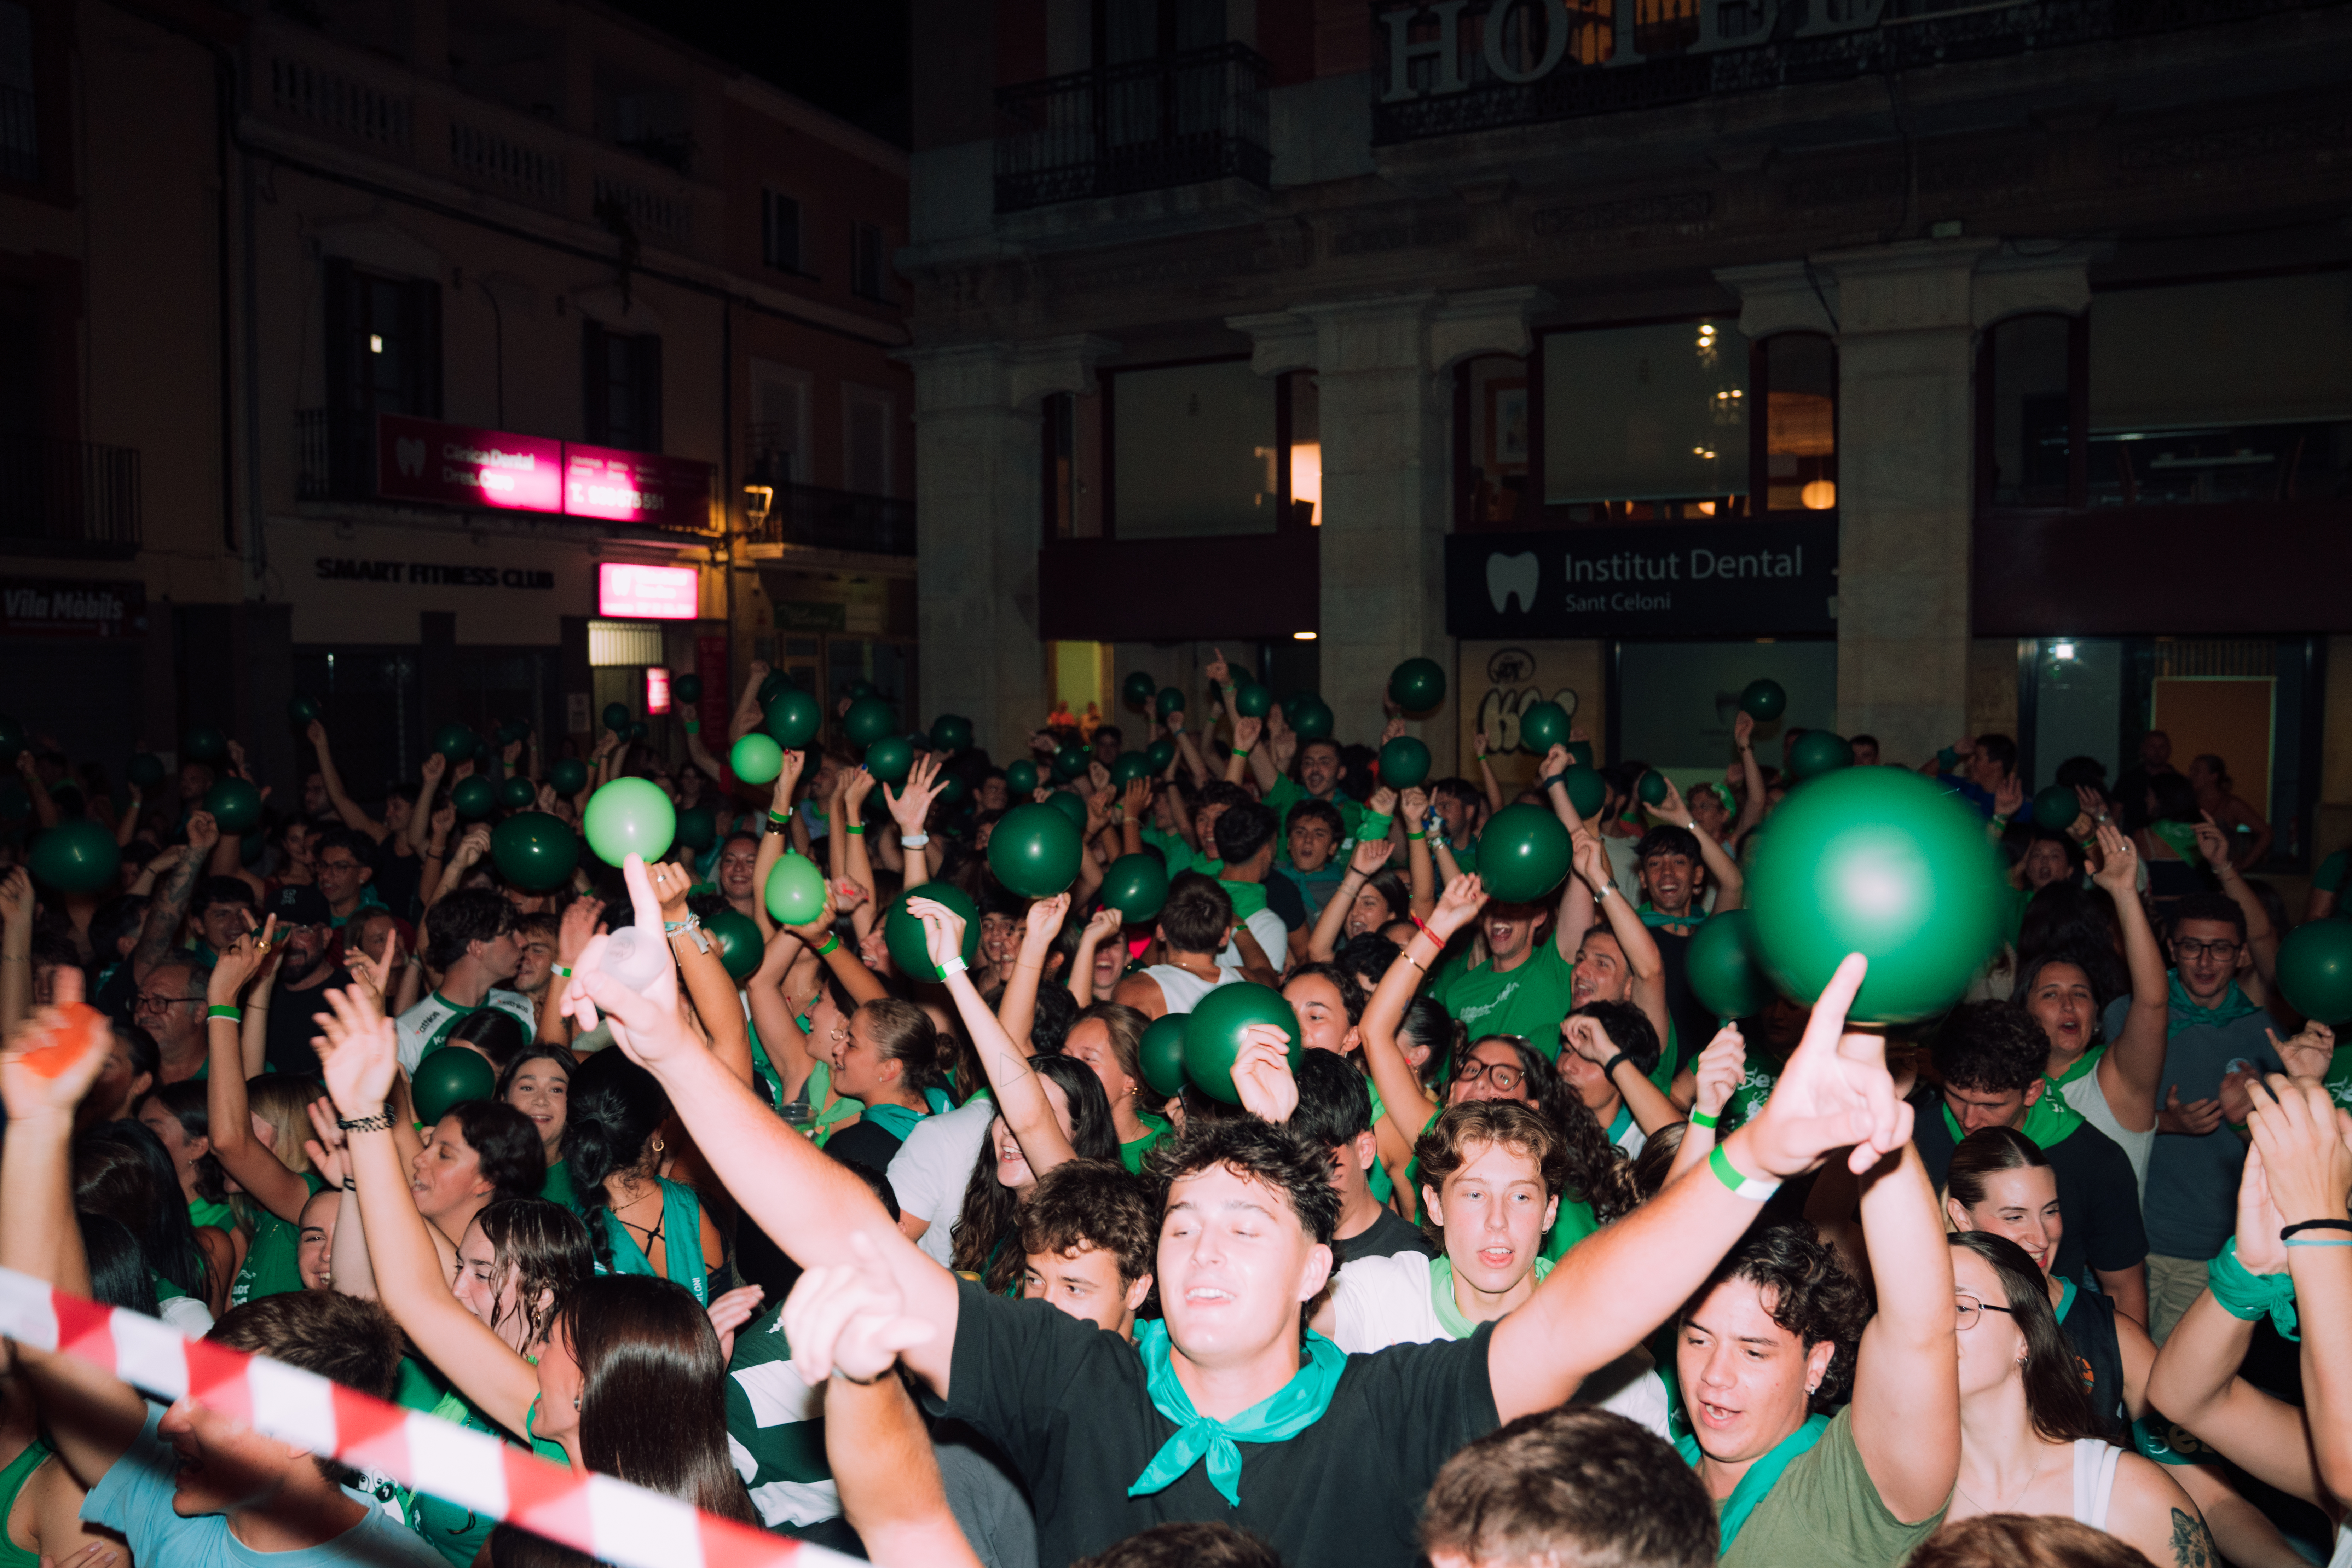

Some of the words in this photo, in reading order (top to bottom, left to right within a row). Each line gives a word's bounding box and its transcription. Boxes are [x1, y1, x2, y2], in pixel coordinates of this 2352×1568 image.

[317, 557, 404, 583] SMART
[410, 564, 498, 586] FITNESS
[503, 568, 554, 589] CLUB
[1564, 551, 1681, 583] Institut
[1689, 544, 1803, 580] Dental
[4, 588, 49, 618] Vila
[52, 590, 124, 620] Mòbils
[1565, 592, 1608, 613] Sant
[1611, 591, 1671, 612] Celoni
